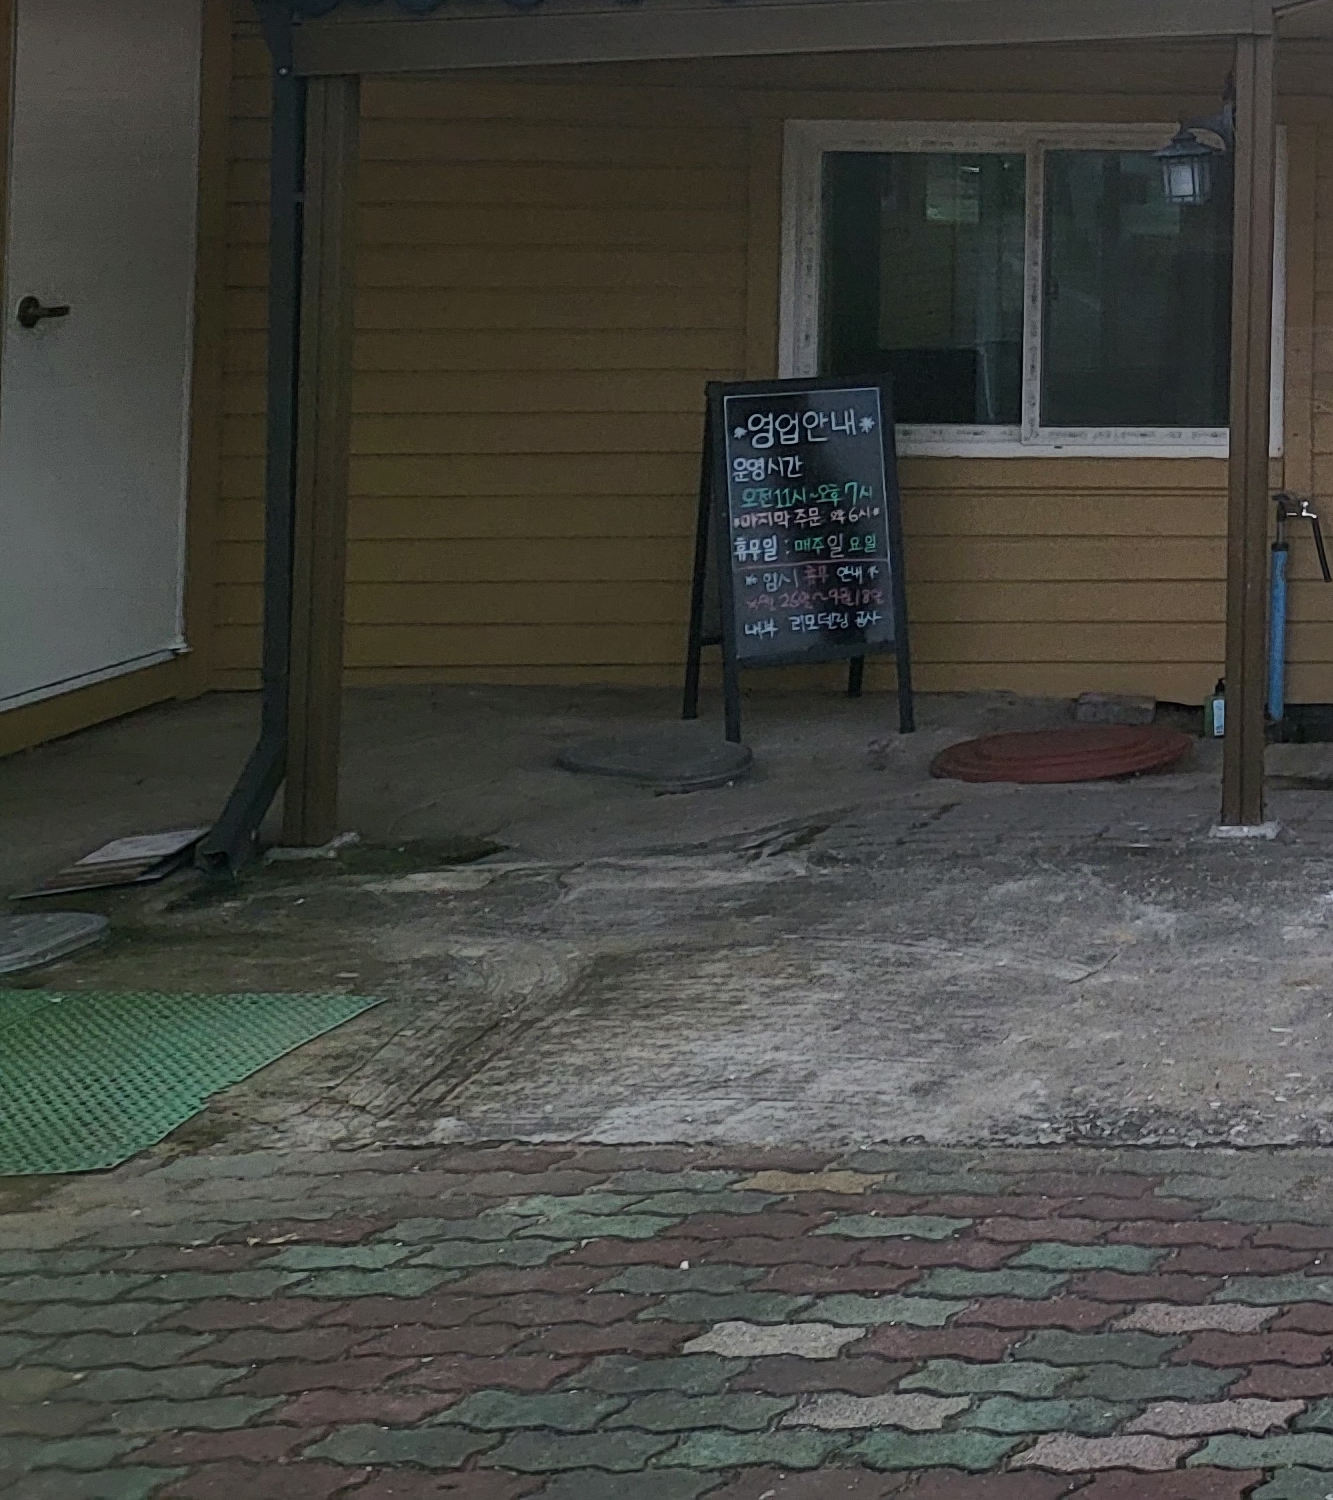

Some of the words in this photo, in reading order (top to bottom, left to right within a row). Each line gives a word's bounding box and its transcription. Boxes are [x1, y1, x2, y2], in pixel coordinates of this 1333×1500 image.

[748, 408, 857, 449] 영업안내
[740, 510, 791, 528] 마지막
[794, 506, 822, 529] 주문
[848, 506, 870, 522] 6시
[762, 568, 799, 592] 임시
